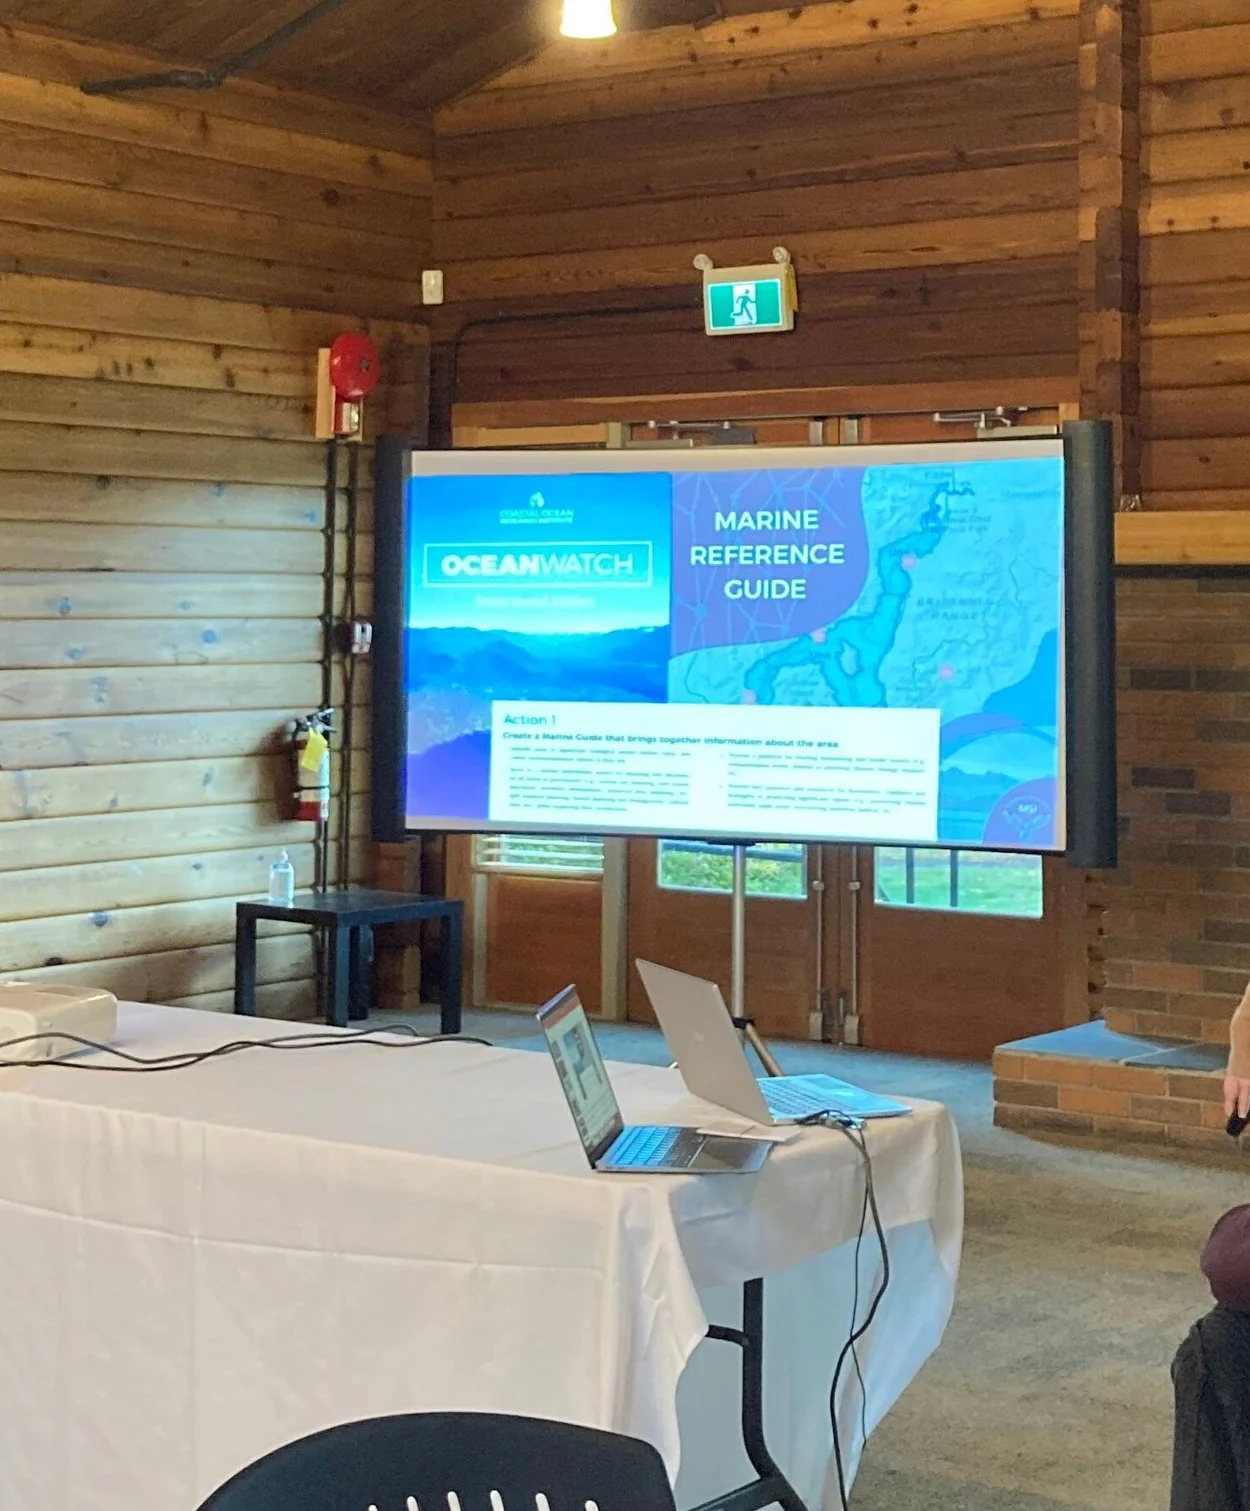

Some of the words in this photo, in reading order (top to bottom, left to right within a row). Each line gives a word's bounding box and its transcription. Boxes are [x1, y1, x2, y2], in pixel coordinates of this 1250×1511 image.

[714, 509, 820, 531] MARINE
[441, 553, 633, 576] OCEANWATCH
[690, 543, 845, 565] REFERENCE
[723, 578, 807, 600] GUIDE
[503, 714, 547, 725] Action
[605, 734, 625, 742] that
[627, 735, 657, 744] brings
[659, 736, 701, 745] together
[703, 737, 762, 746] information
[765, 739, 794, 747] about
[797, 740, 814, 748] the
